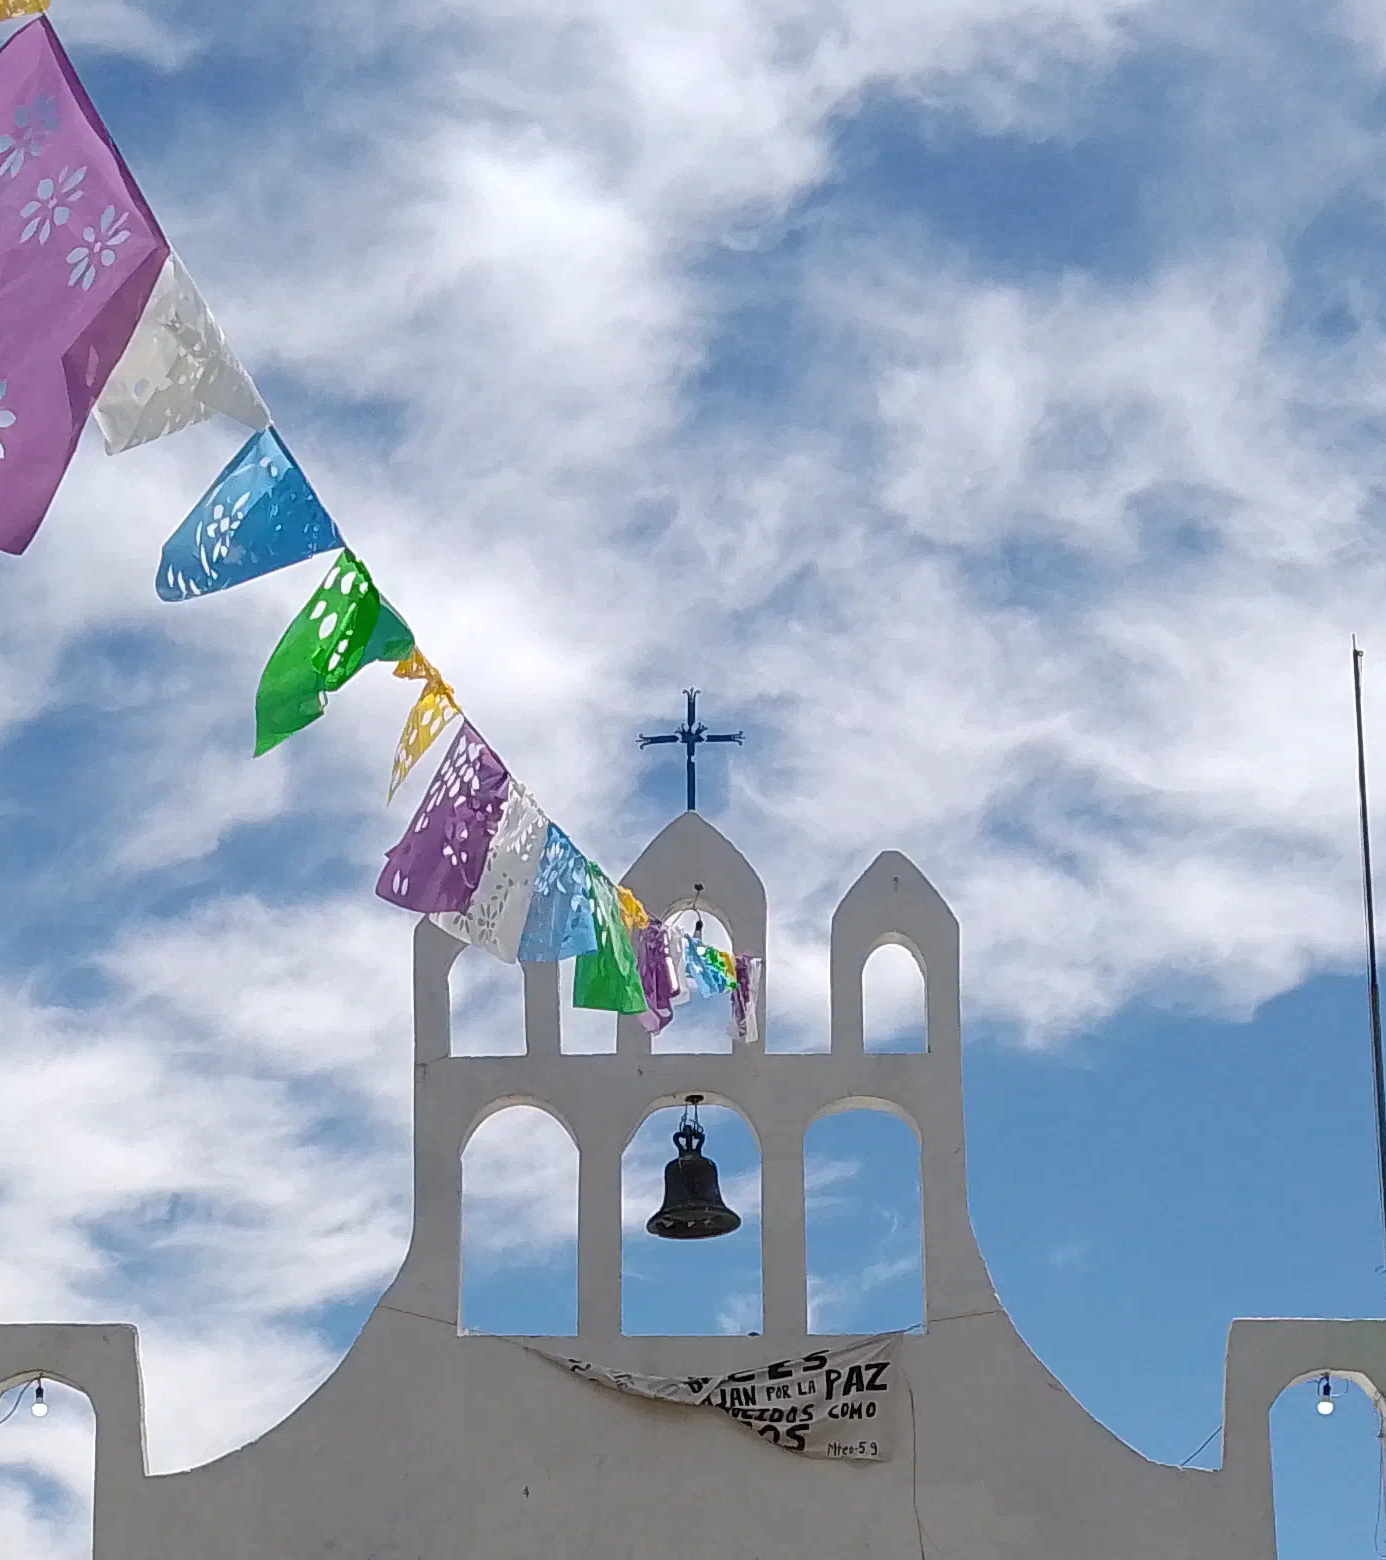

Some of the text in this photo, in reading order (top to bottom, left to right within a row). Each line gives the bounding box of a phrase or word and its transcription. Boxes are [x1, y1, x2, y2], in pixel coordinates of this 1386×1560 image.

[766, 1384, 791, 1401] POR
[797, 1380, 816, 1396] LA
[825, 1362, 888, 1400] PAZ
[828, 1402, 876, 1420] COMO
